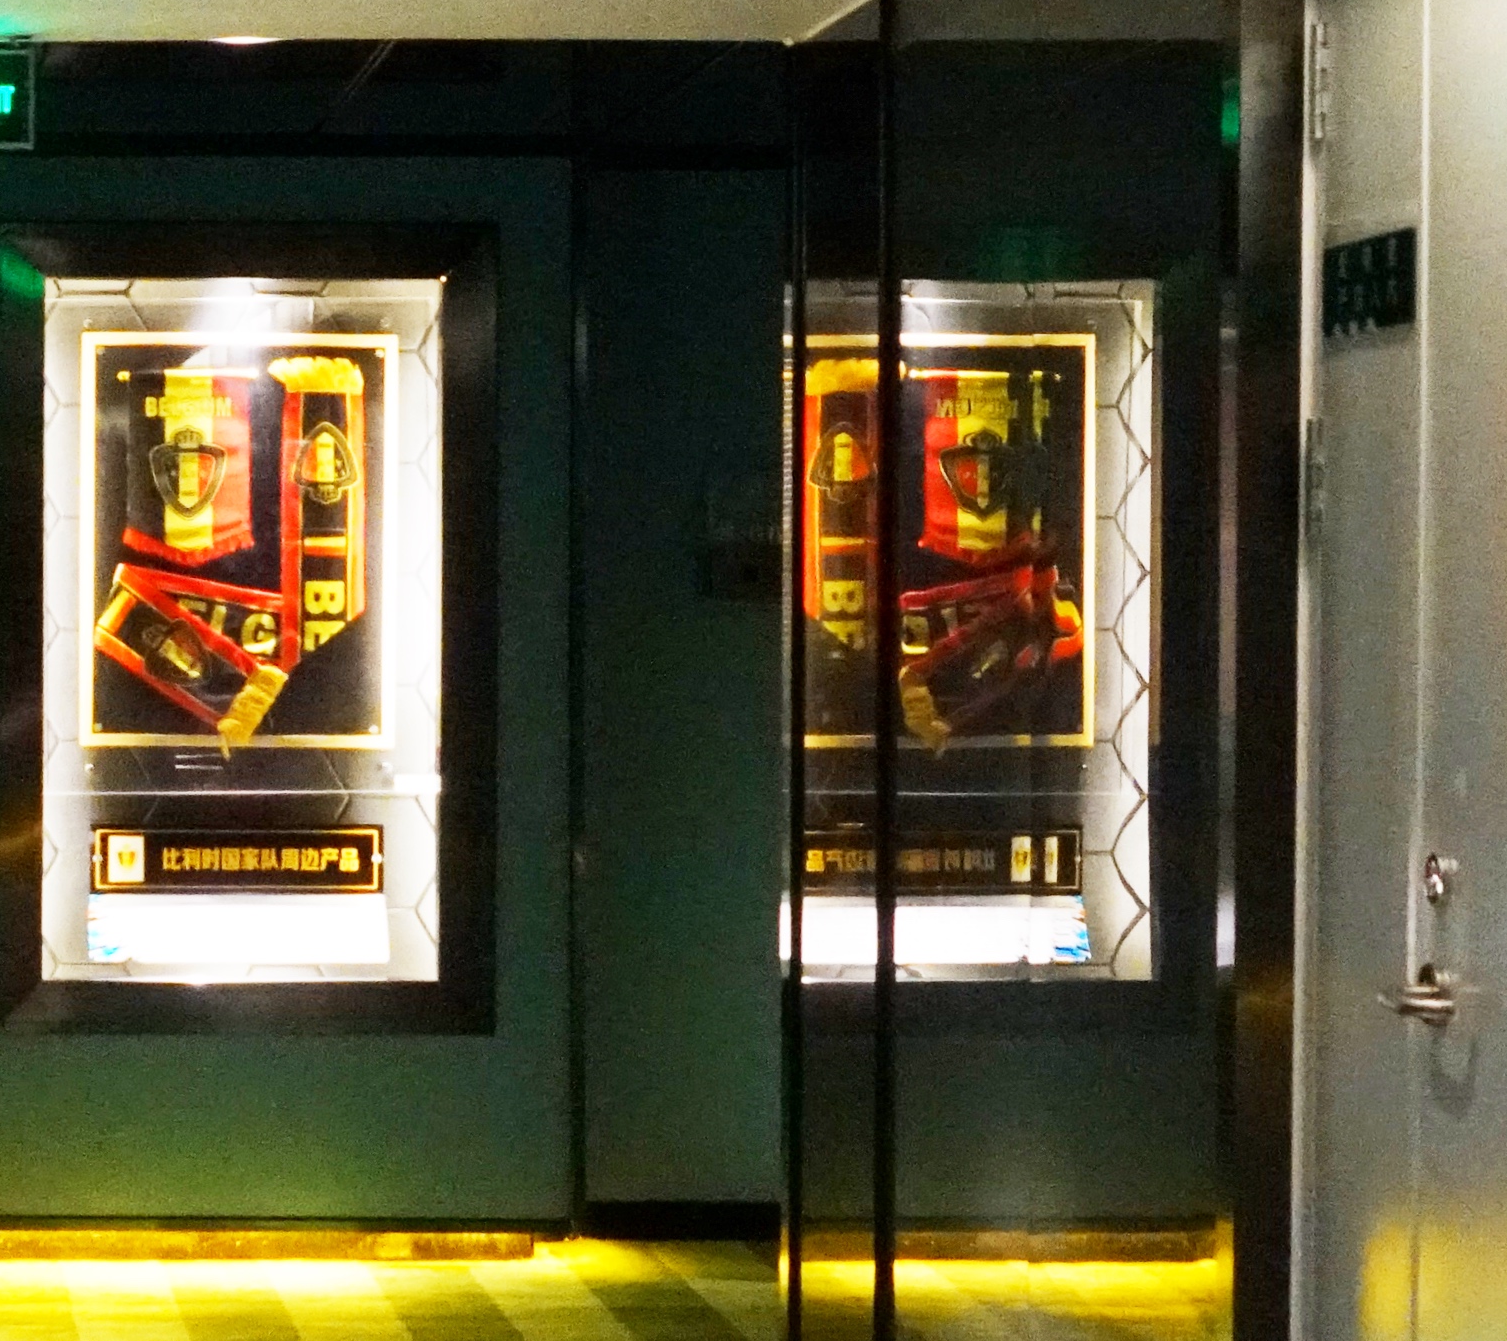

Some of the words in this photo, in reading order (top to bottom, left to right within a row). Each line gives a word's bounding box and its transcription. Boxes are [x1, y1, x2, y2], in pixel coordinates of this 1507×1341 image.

[161, 847, 359, 872] 比利时国家队周边产品
